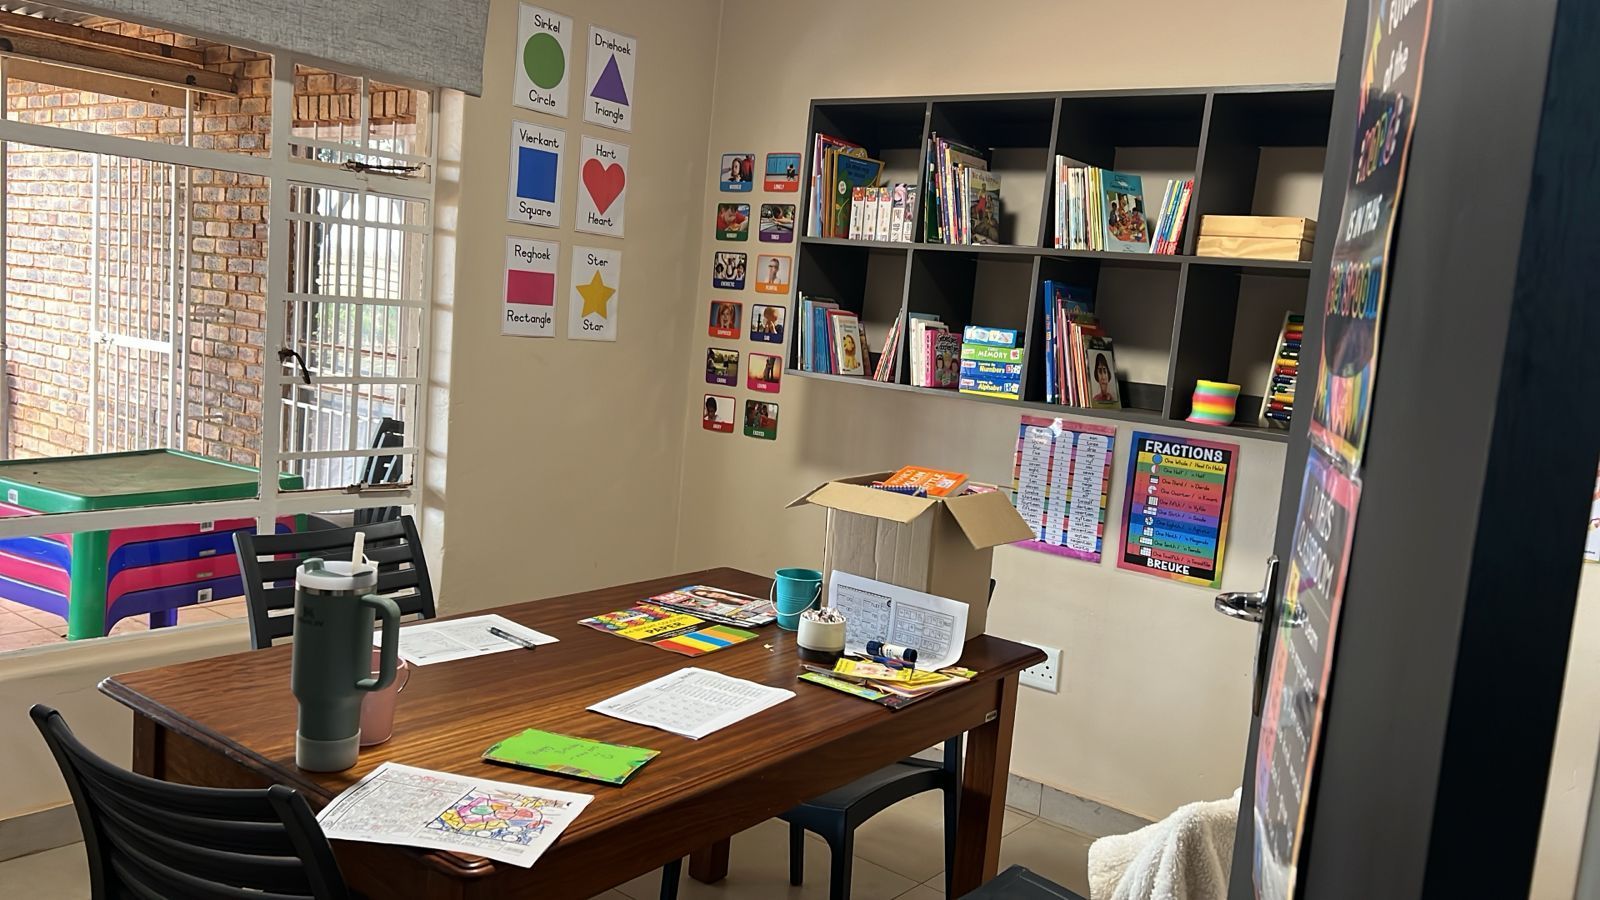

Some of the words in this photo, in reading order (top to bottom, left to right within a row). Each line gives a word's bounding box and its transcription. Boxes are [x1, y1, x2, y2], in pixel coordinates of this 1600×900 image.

[534, 14, 560, 34] Sirkel
[595, 34, 631, 55] Driehoek
[528, 89, 556, 107] Circle
[594, 102, 624, 124] Triangle
[519, 128, 559, 148] Vierkant
[596, 145, 616, 159] Hart
[519, 202, 551, 220] Square
[588, 212, 613, 227] Heart
[514, 245, 551, 264] Reghoek
[587, 254, 608, 267] Ster
[507, 310, 551, 328] Rectangle
[583, 320, 603, 331] Star
[1145, 440, 1223, 462] FRACTIONS
[1147, 558, 1190, 574] BREUKE
[645, 623, 684, 634] PAPER
